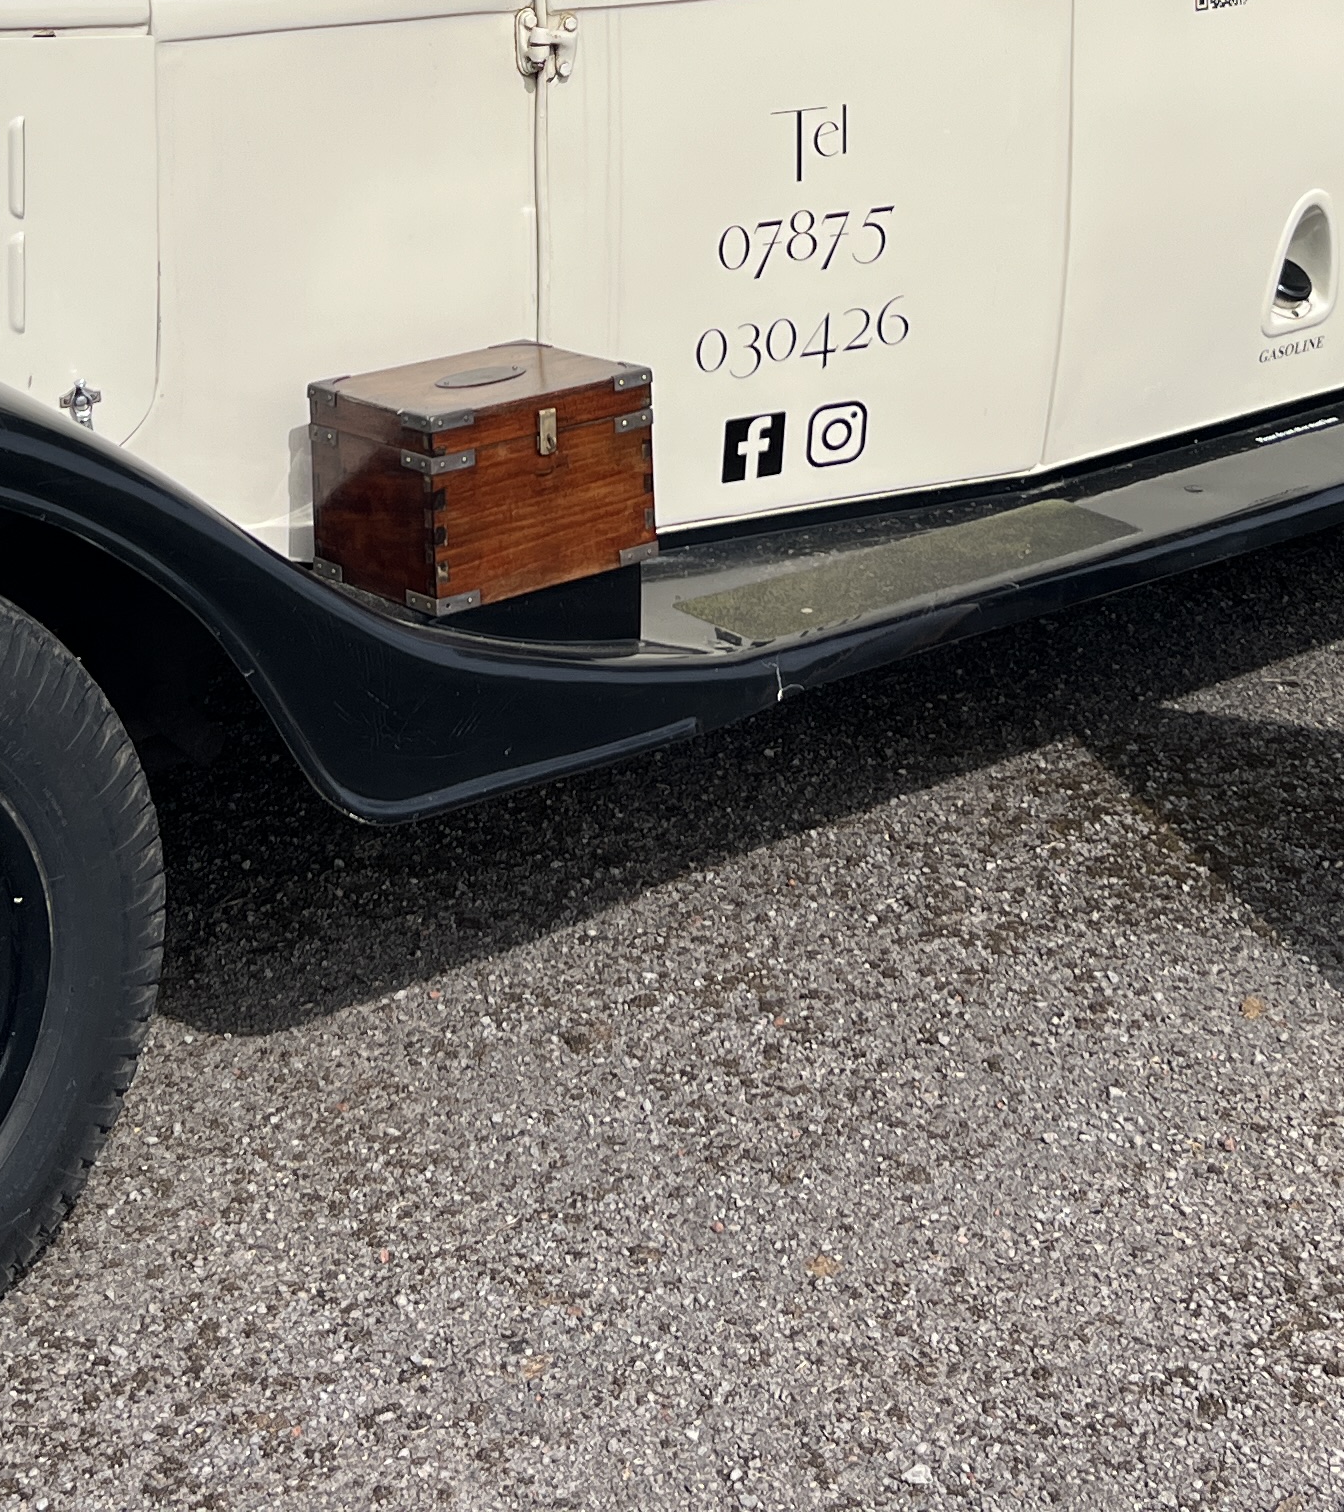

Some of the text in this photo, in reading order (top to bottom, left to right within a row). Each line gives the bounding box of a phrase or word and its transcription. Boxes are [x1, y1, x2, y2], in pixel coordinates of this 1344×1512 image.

[771, 104, 847, 182] Tel
[719, 205, 895, 280] 07875
[696, 296, 909, 378] 030426
[1258, 336, 1324, 363] GASOLINE
